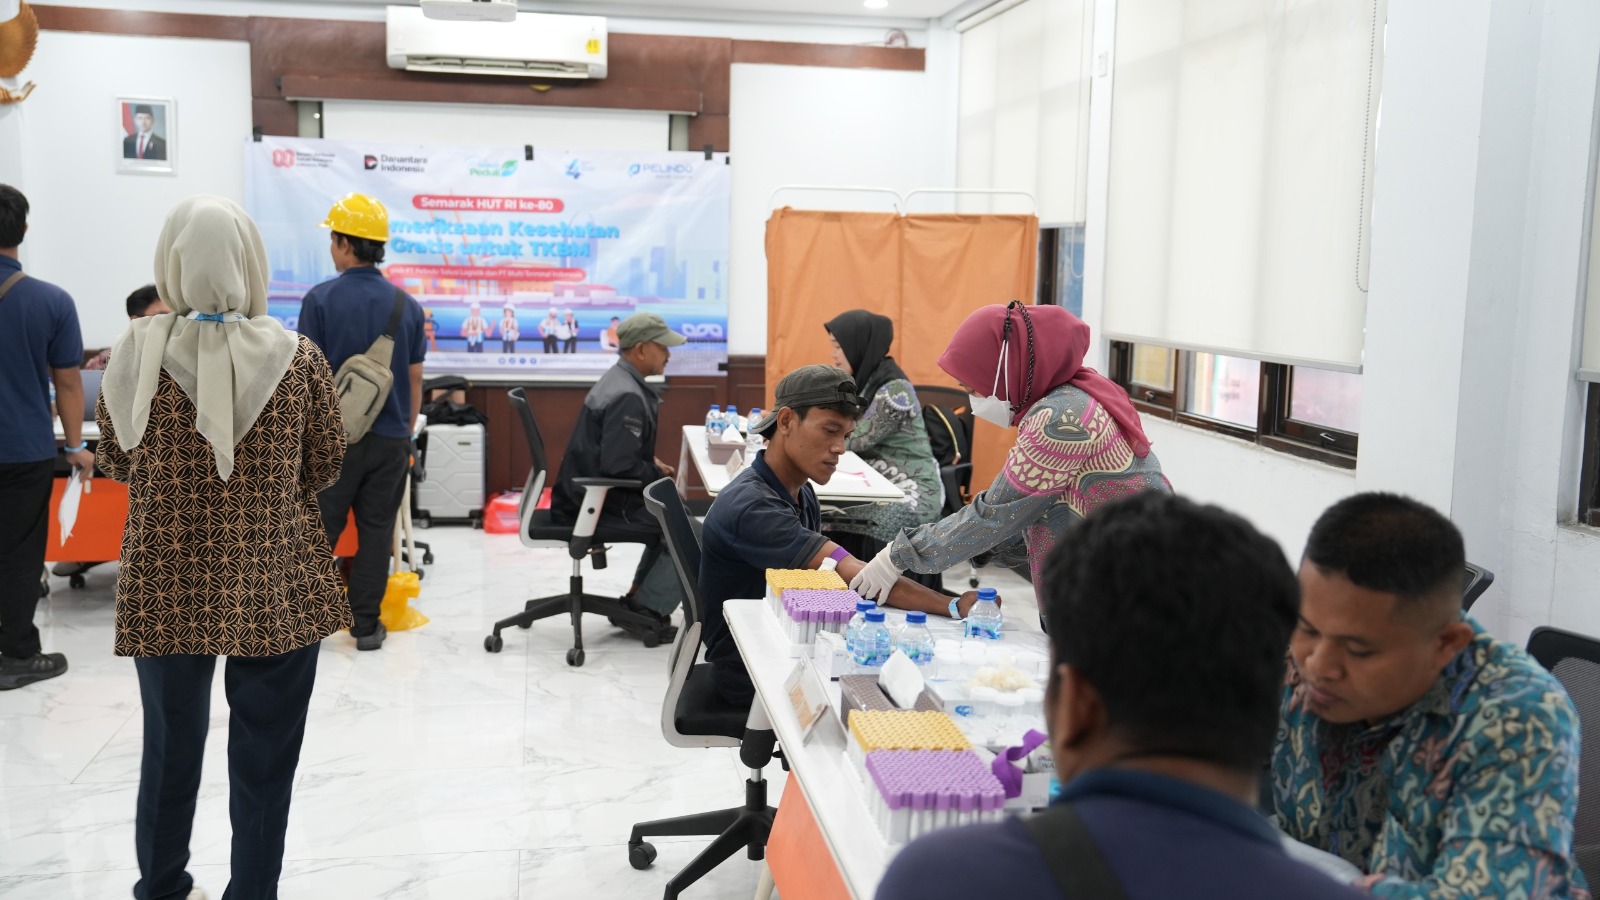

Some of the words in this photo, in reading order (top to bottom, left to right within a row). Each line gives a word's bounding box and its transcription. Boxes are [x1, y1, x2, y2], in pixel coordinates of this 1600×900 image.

[381, 154, 428, 164] Danantara
[381, 164, 425, 173] Indonesia
[469, 168, 500, 177] Peduli
[643, 163, 694, 174] PELINDO
[421, 196, 474, 208] Semarak
[477, 198, 503, 209] HUT
[504, 199, 517, 209] RI
[519, 199, 554, 211] ke-80
[389, 217, 504, 236] meriksaan
[509, 220, 620, 239] Kesehatan
[391, 237, 454, 255] Gratis
[459, 240, 523, 256] untuk
[529, 241, 591, 258] TKBM
